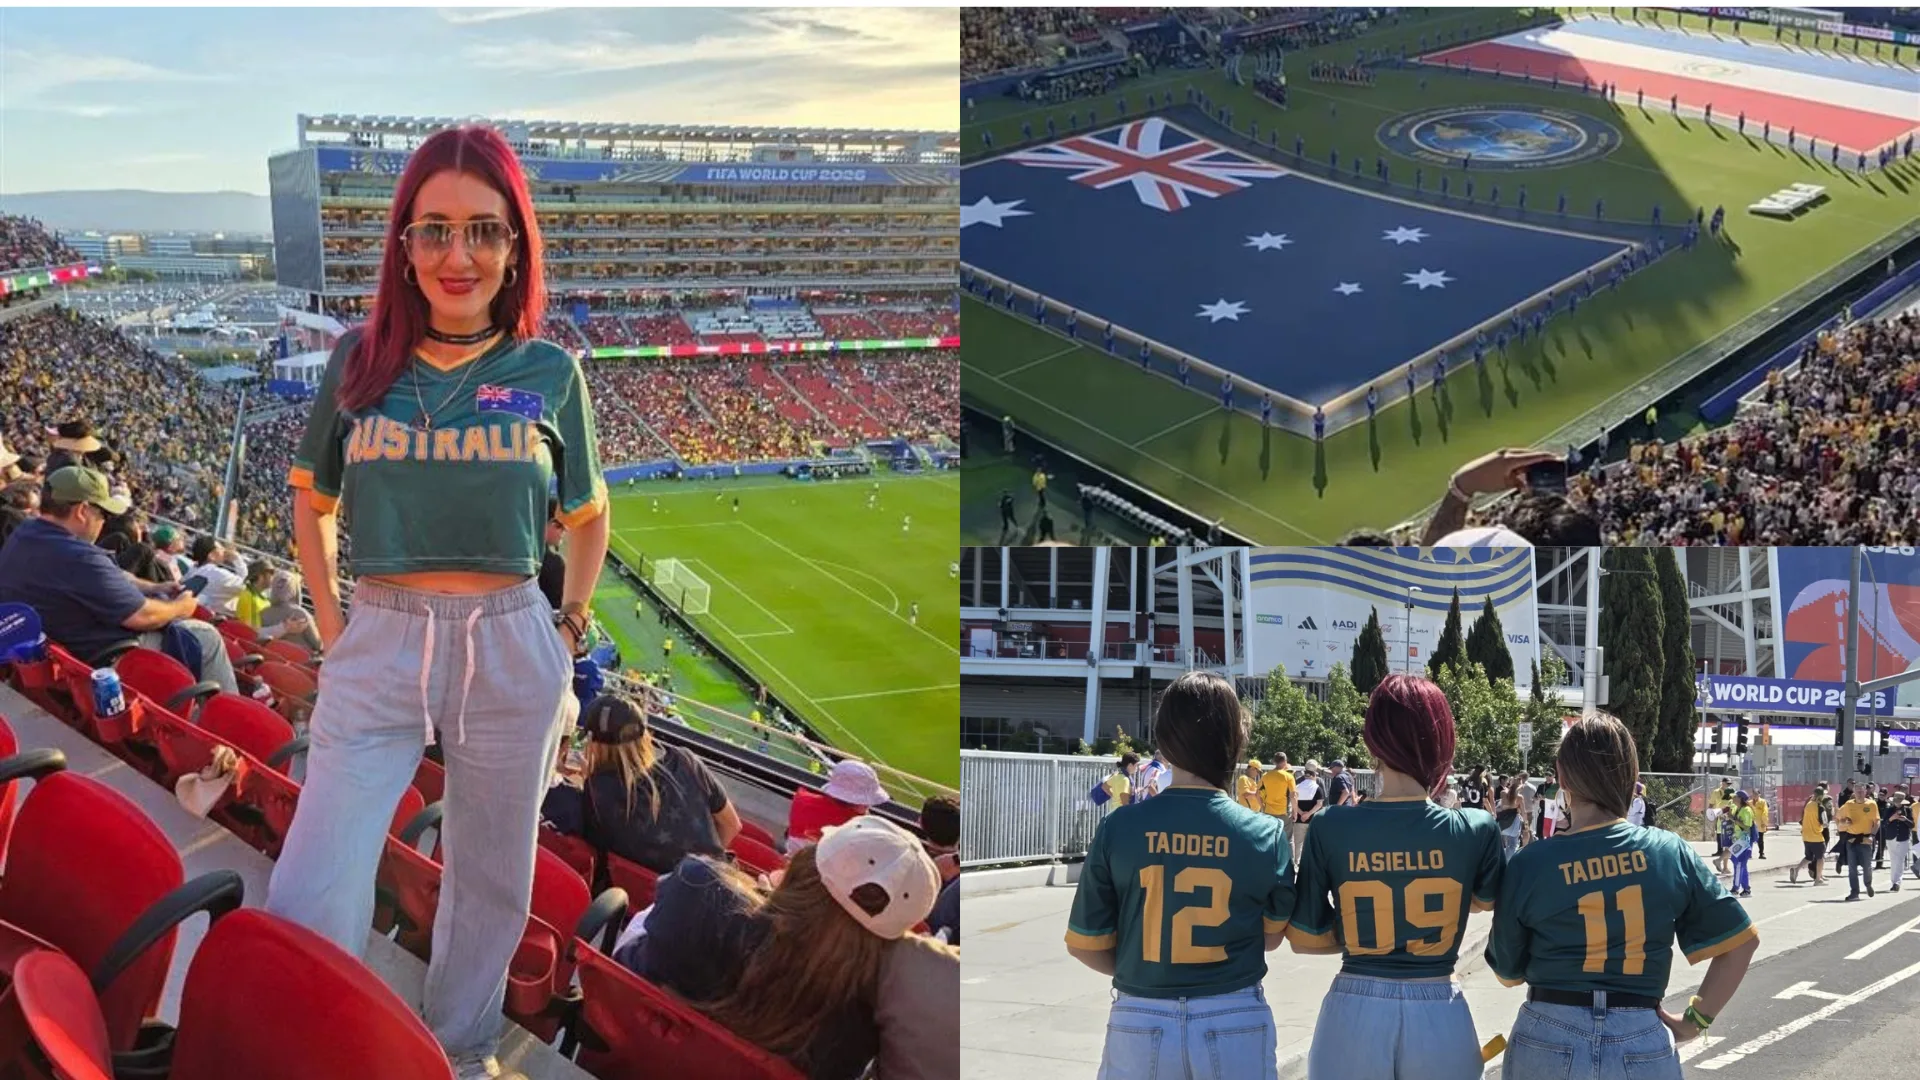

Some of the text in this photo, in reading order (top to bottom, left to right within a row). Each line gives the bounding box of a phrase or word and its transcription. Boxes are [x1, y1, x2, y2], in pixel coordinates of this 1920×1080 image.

[707, 168, 867, 181] FIFA WORLD CUP 2026
[1257, 615, 1282, 623] aramco
[1507, 634, 1530, 644] VISA
[1714, 683, 1783, 703] WORLD
[1786, 687, 1822, 705] CUP
[1145, 831, 1229, 858] TADDEO
[1349, 849, 1444, 872] IASIELLO
[1558, 850, 1648, 885] TADDEO
[1139, 864, 1233, 964] 12
[1338, 877, 1463, 956] 09
[1577, 884, 1647, 975] 11
